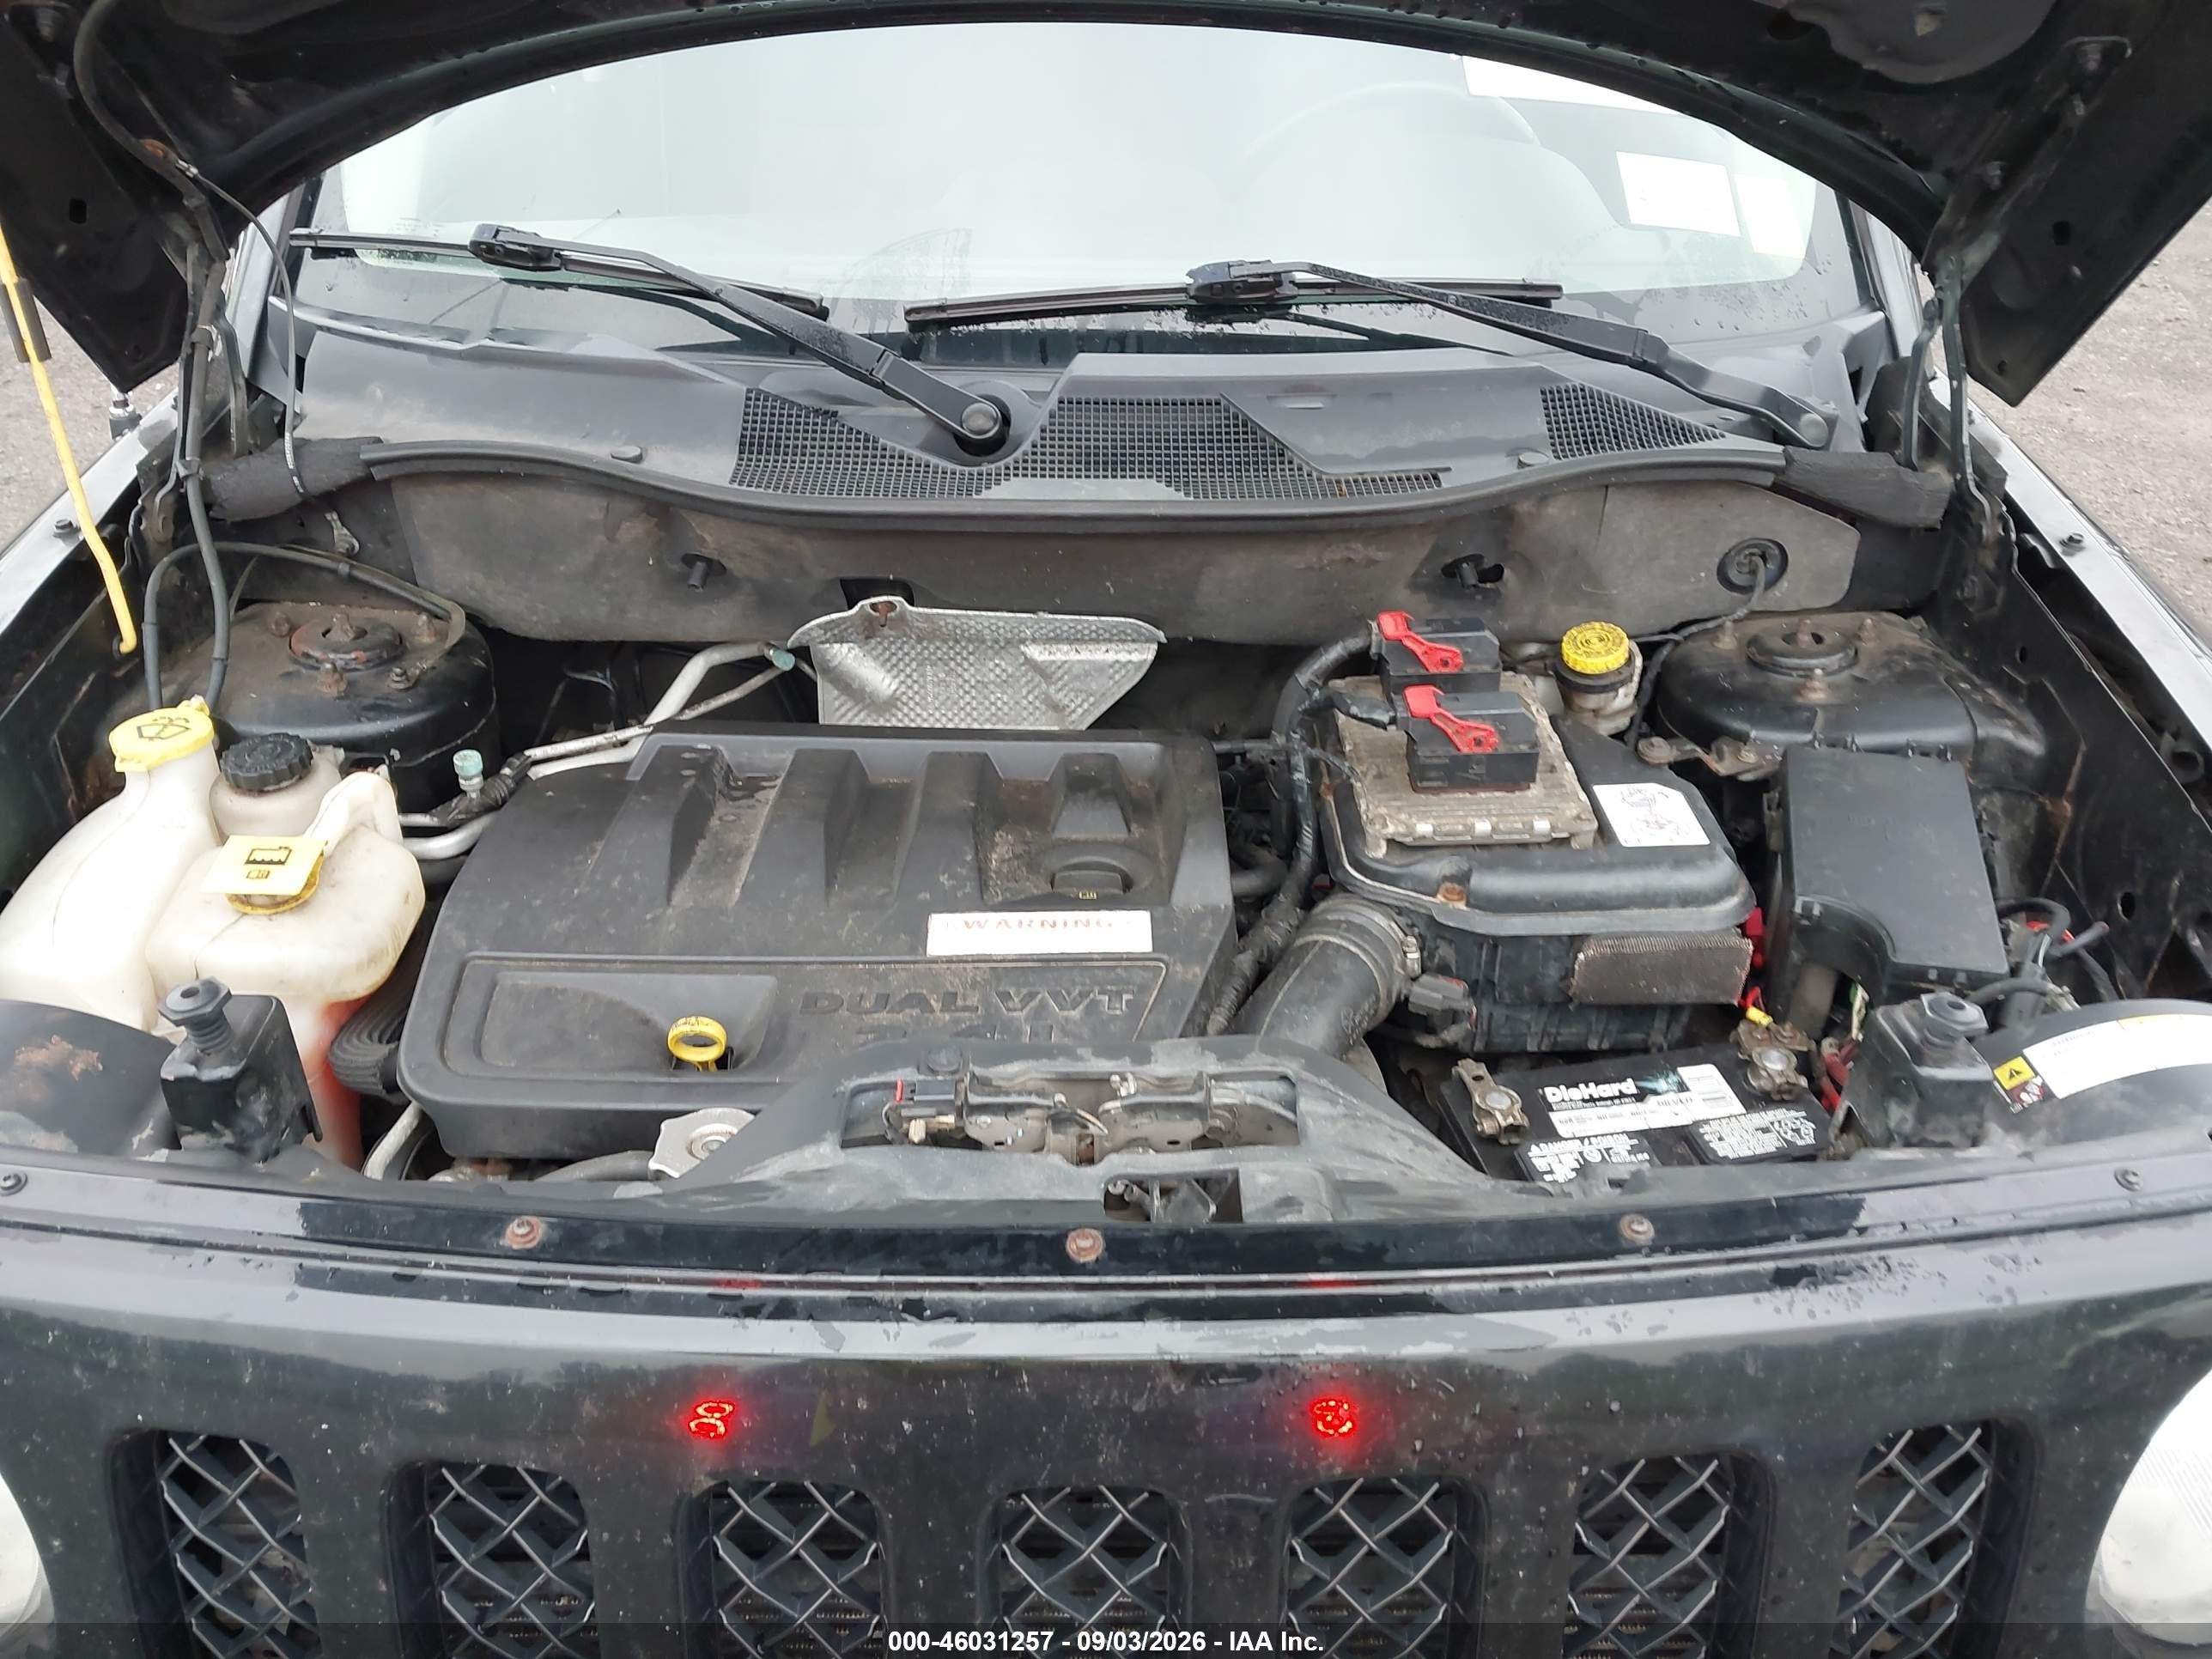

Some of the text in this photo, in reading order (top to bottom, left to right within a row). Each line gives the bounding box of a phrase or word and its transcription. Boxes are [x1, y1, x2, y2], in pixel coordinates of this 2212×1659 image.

[963, 918, 1114, 930] WARNING
[799, 988, 1136, 1016] DUAL VVT
[1544, 1078, 1640, 1103] DieHard
